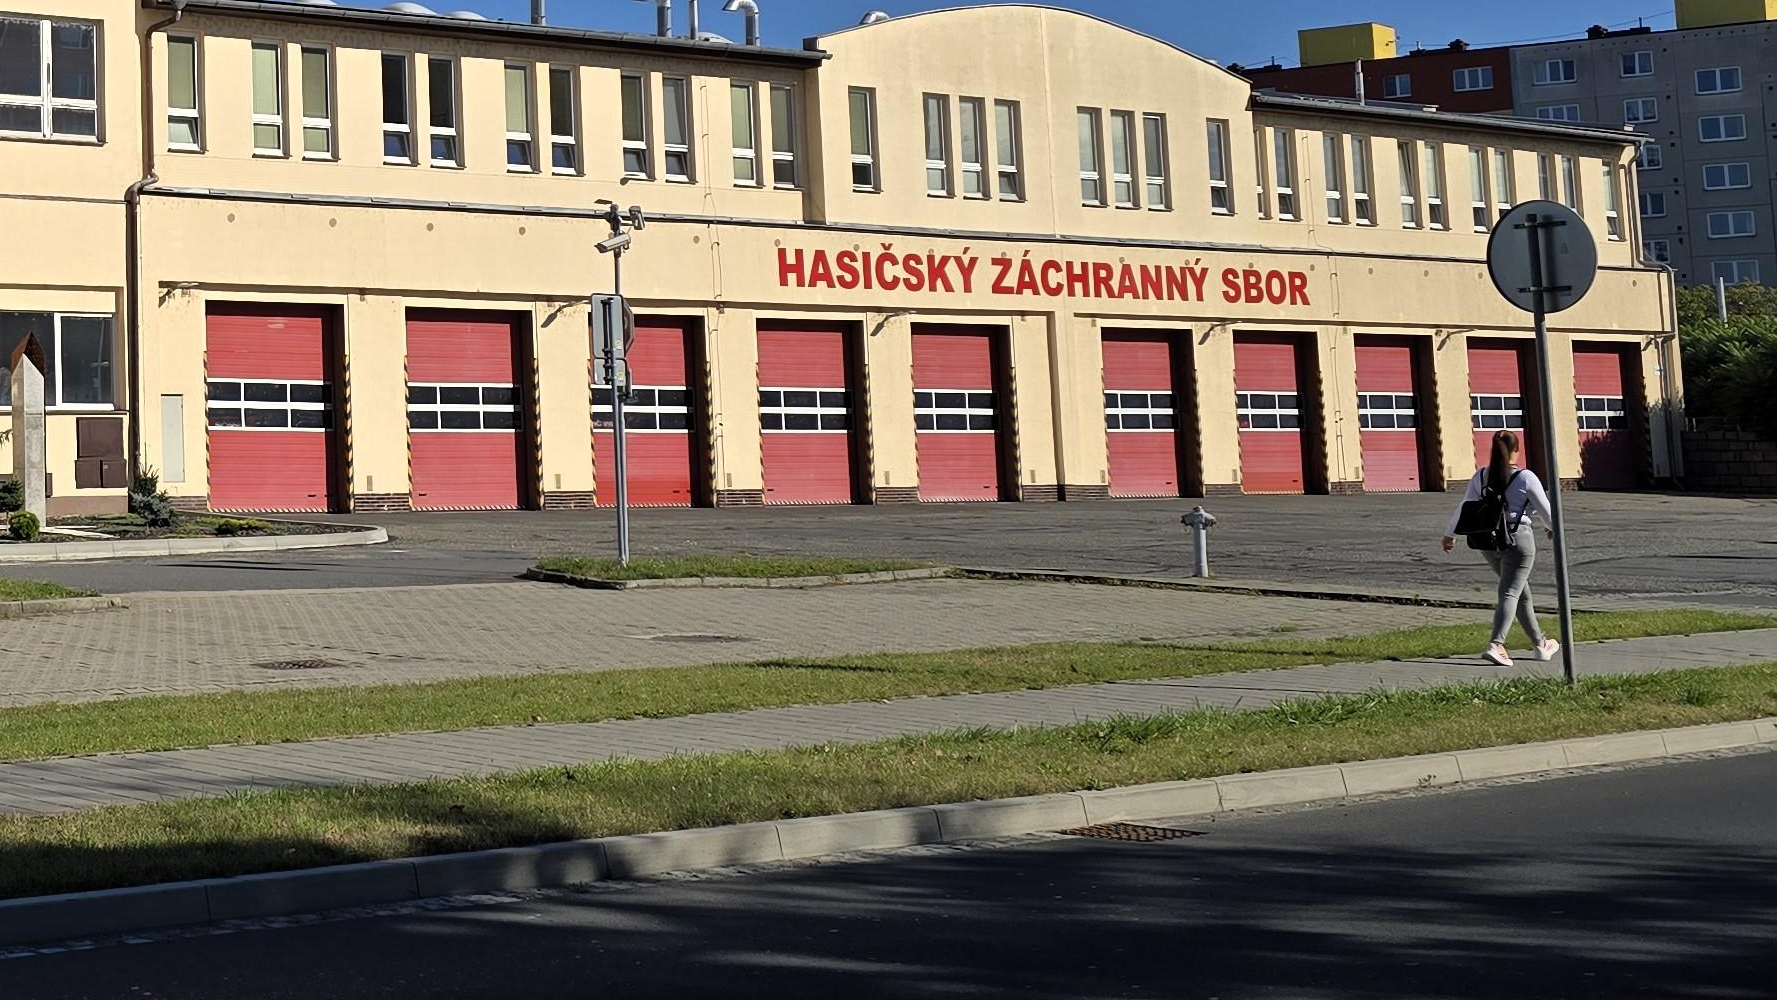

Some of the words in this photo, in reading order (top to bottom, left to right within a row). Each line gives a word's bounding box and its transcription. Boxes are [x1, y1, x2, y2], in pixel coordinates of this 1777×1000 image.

[777, 242, 978, 294] HASIČSKÝ
[990, 249, 1209, 303] ZÁCHRANNÝ
[1220, 267, 1312, 306] SBOR
